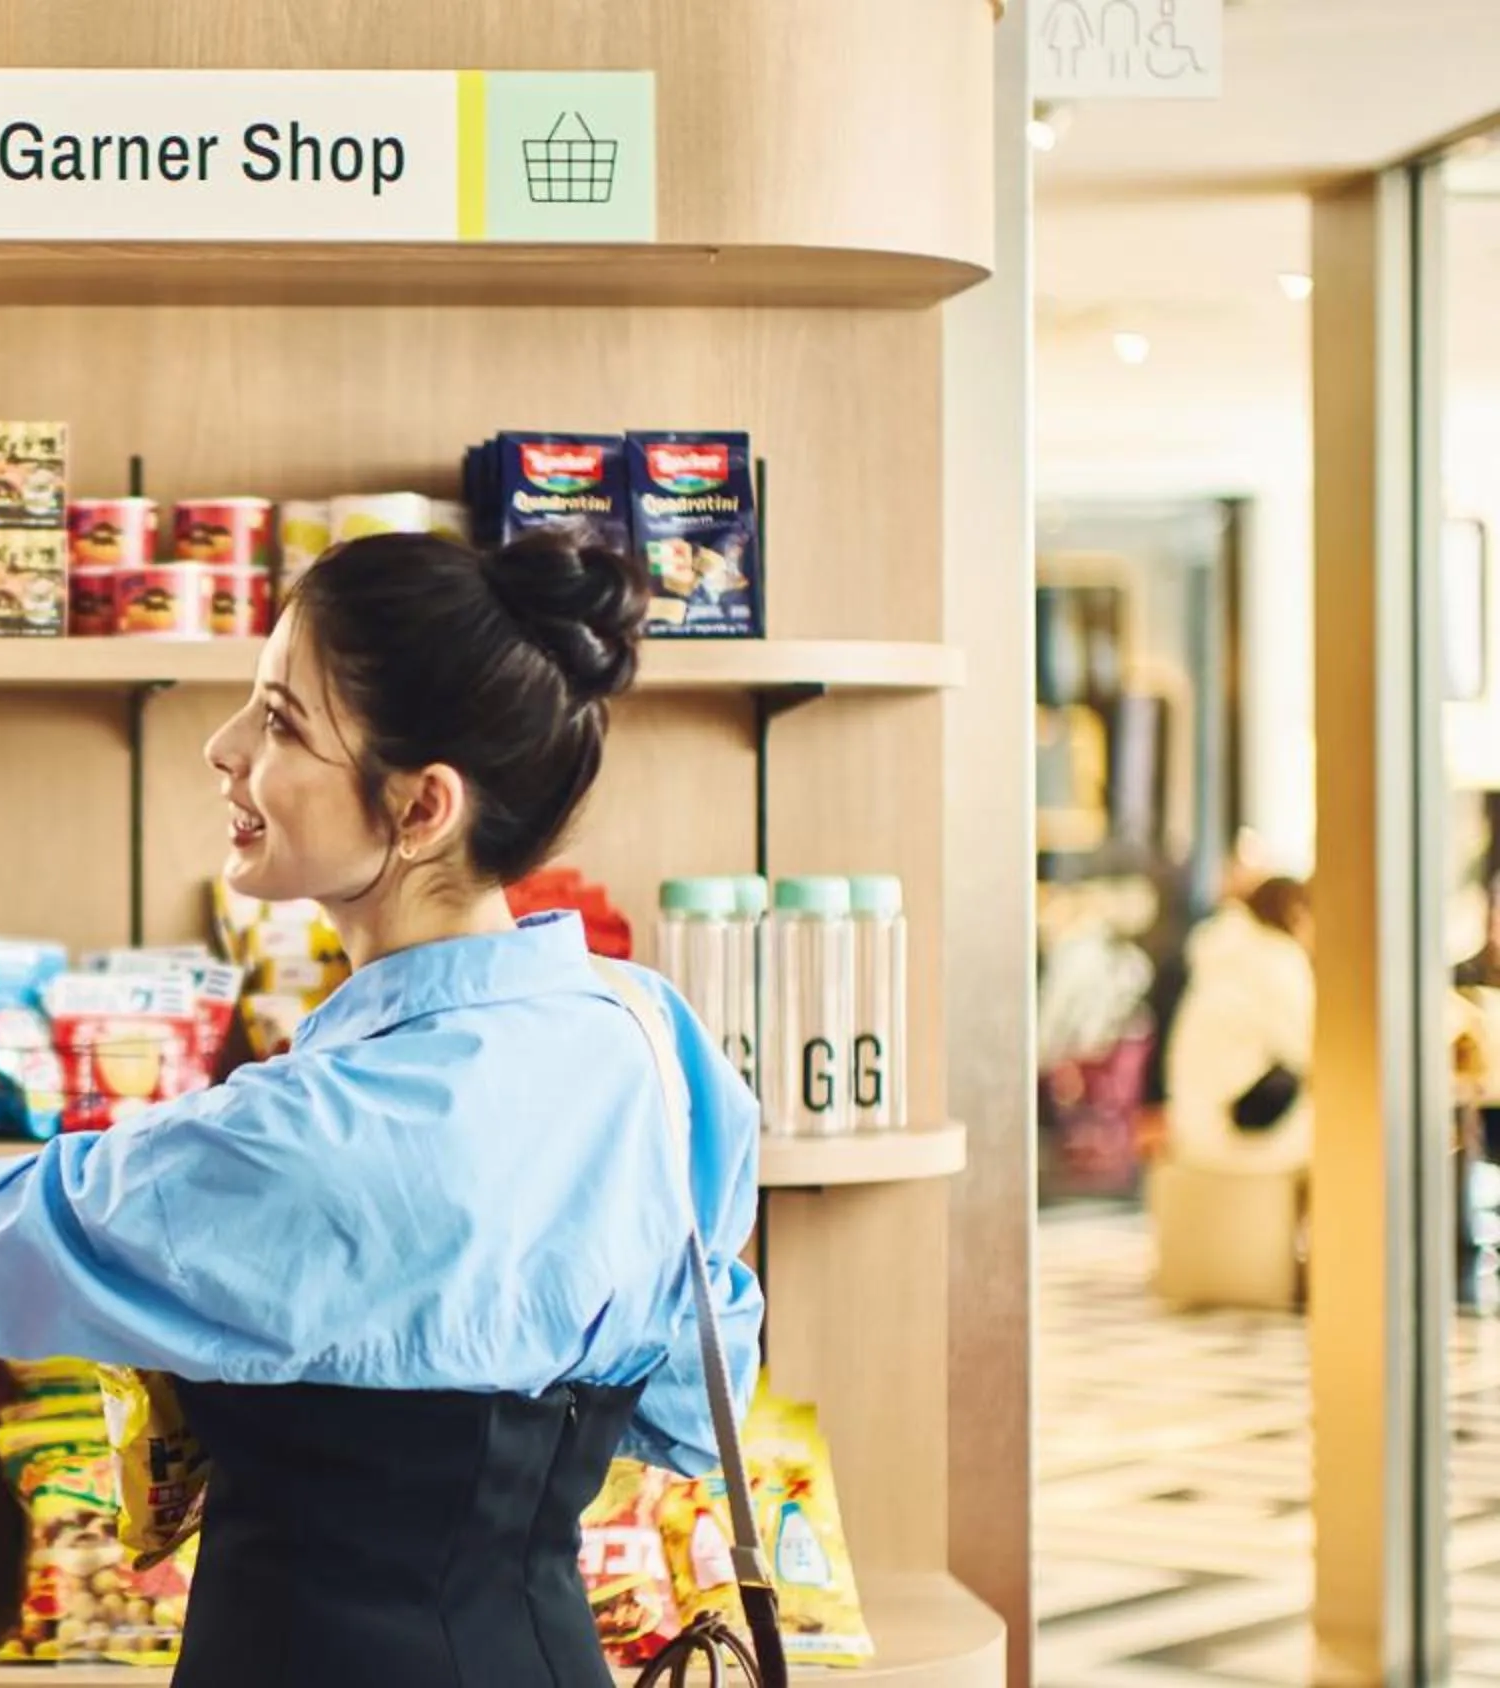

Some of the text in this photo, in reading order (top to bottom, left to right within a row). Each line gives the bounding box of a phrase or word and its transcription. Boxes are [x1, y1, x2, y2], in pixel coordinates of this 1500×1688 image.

[242, 121, 406, 196] Shop
[641, 493, 739, 516] Quadratini
[802, 1036, 835, 1113] G
[853, 1032, 883, 1108] G
